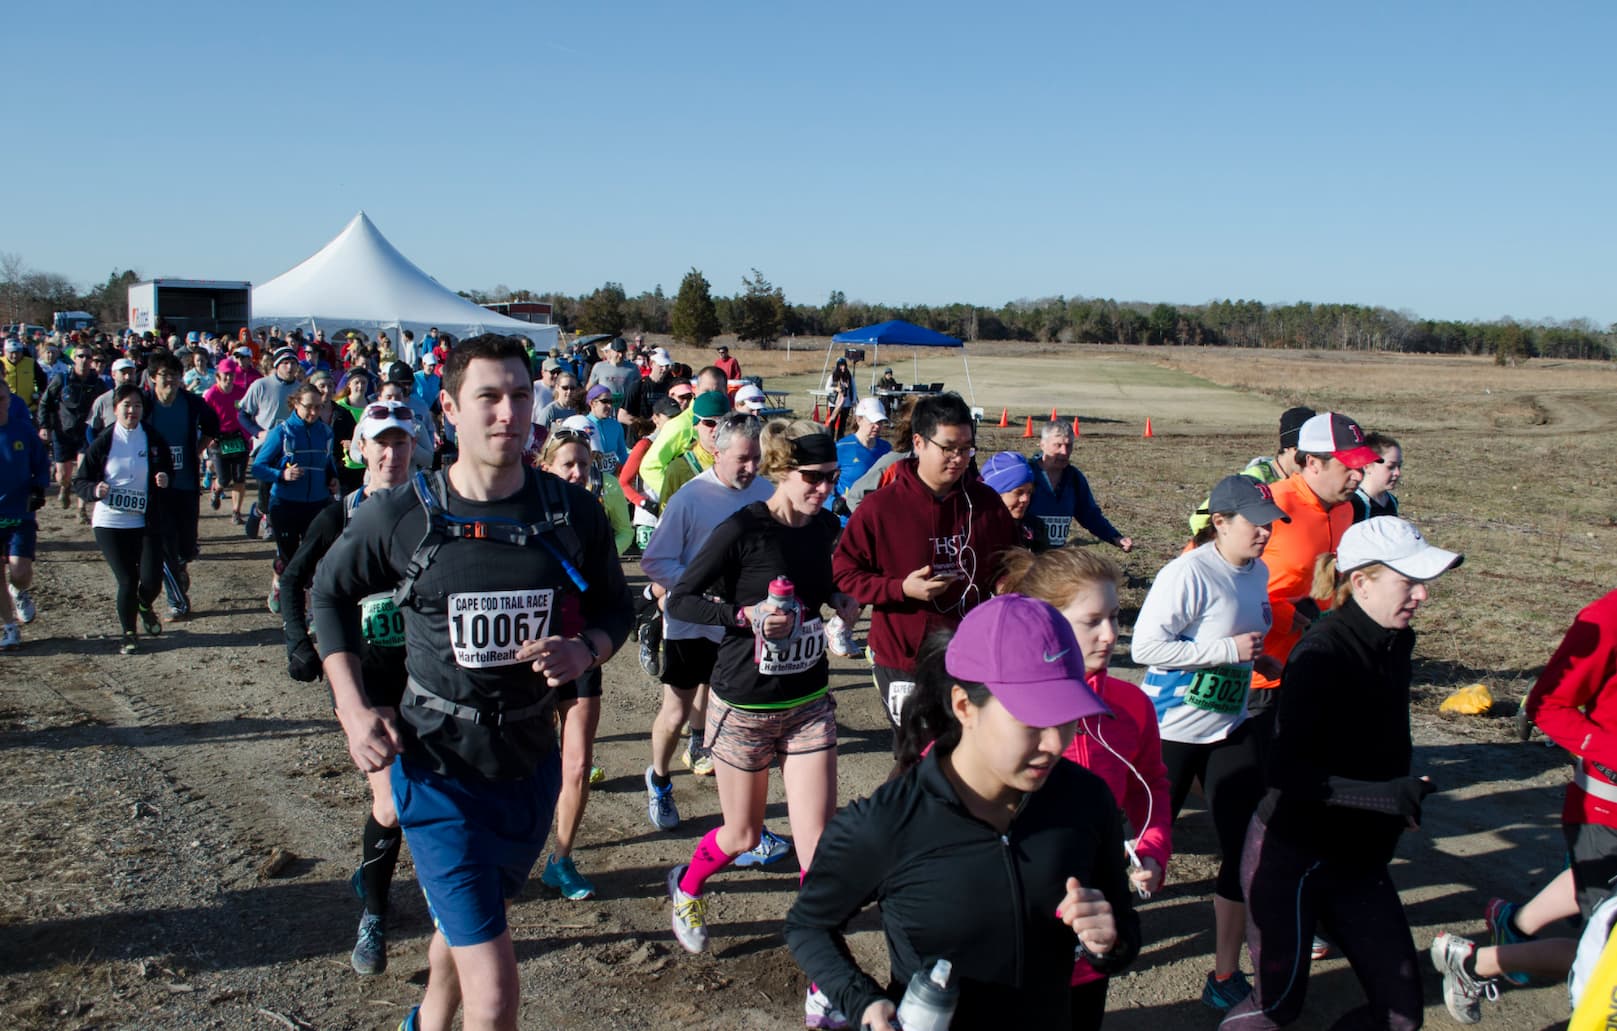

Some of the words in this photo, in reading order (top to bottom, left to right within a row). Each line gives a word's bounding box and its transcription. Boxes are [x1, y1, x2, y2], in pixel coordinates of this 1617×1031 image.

[109, 493, 146, 510] 10089
[456, 598, 479, 611] CAPE
[481, 597, 498, 611] COD
[501, 595, 524, 610] TRAIL
[526, 594, 548, 608] RACE
[452, 610, 549, 649] 10067
